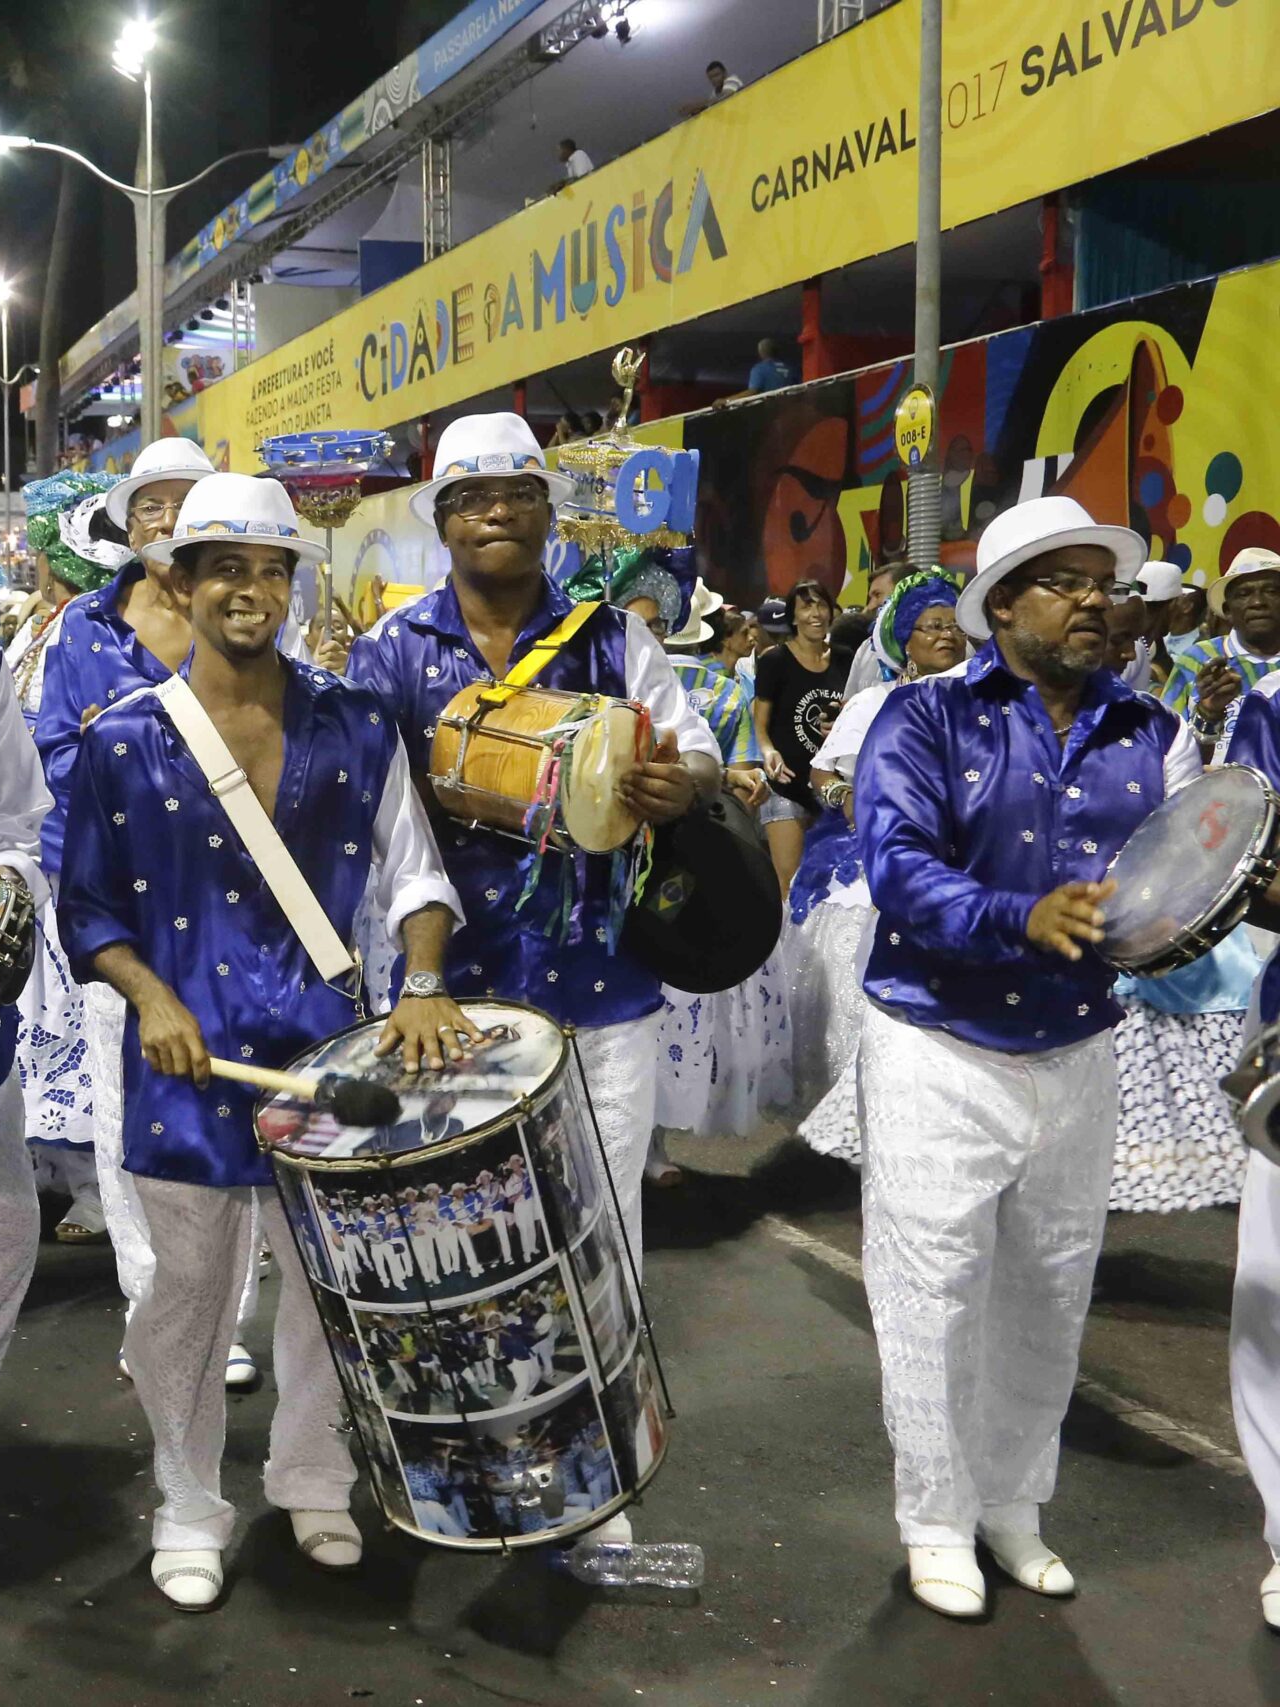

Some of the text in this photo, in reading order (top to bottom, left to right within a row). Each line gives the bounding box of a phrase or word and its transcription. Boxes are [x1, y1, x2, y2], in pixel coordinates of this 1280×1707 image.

[433, 6, 497, 73] PASSARELA
[751, 0, 1239, 213] CARNAVAL 017 SALVAD
[356, 282, 474, 401] CIDADE
[530, 168, 728, 332] MÚSICA
[251, 338, 334, 400] A PREFEITURA E VOCÊ
[246, 371, 342, 427] FAZENDO A MAIOR FESTA
[282, 416, 293, 434] DO
[295, 404, 332, 432] PLANETA
[901, 425, 926, 447] 008-E
[795, 689, 818, 715] ALWAYS
[816, 688, 830, 699] HE
[794, 715, 803, 723] IS
[795, 724, 819, 754] ROBLEMS
